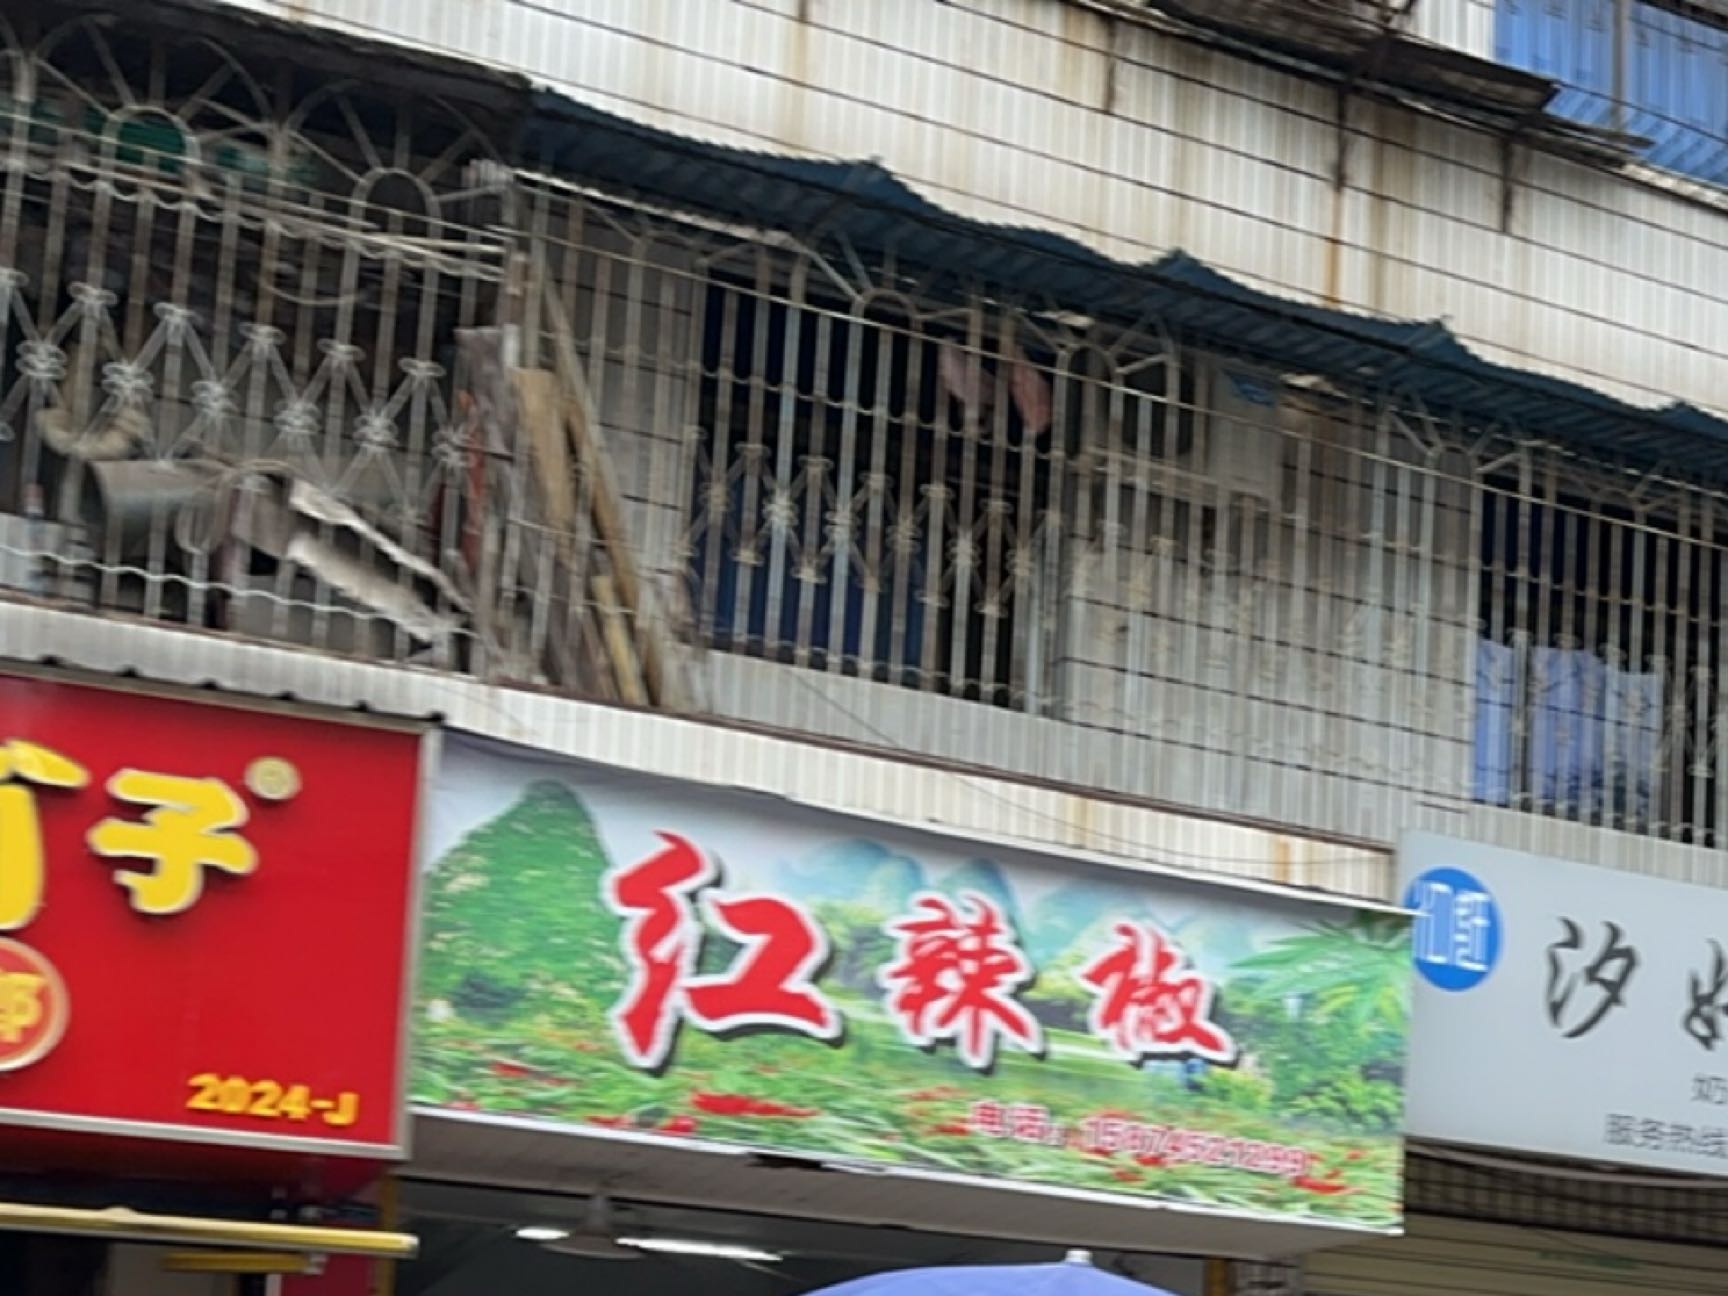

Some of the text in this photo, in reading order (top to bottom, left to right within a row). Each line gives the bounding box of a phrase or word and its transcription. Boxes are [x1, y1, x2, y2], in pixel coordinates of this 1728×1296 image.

[612, 830, 1236, 1070] 红辣椒
[186, 1072, 359, 1127] 2024-J
